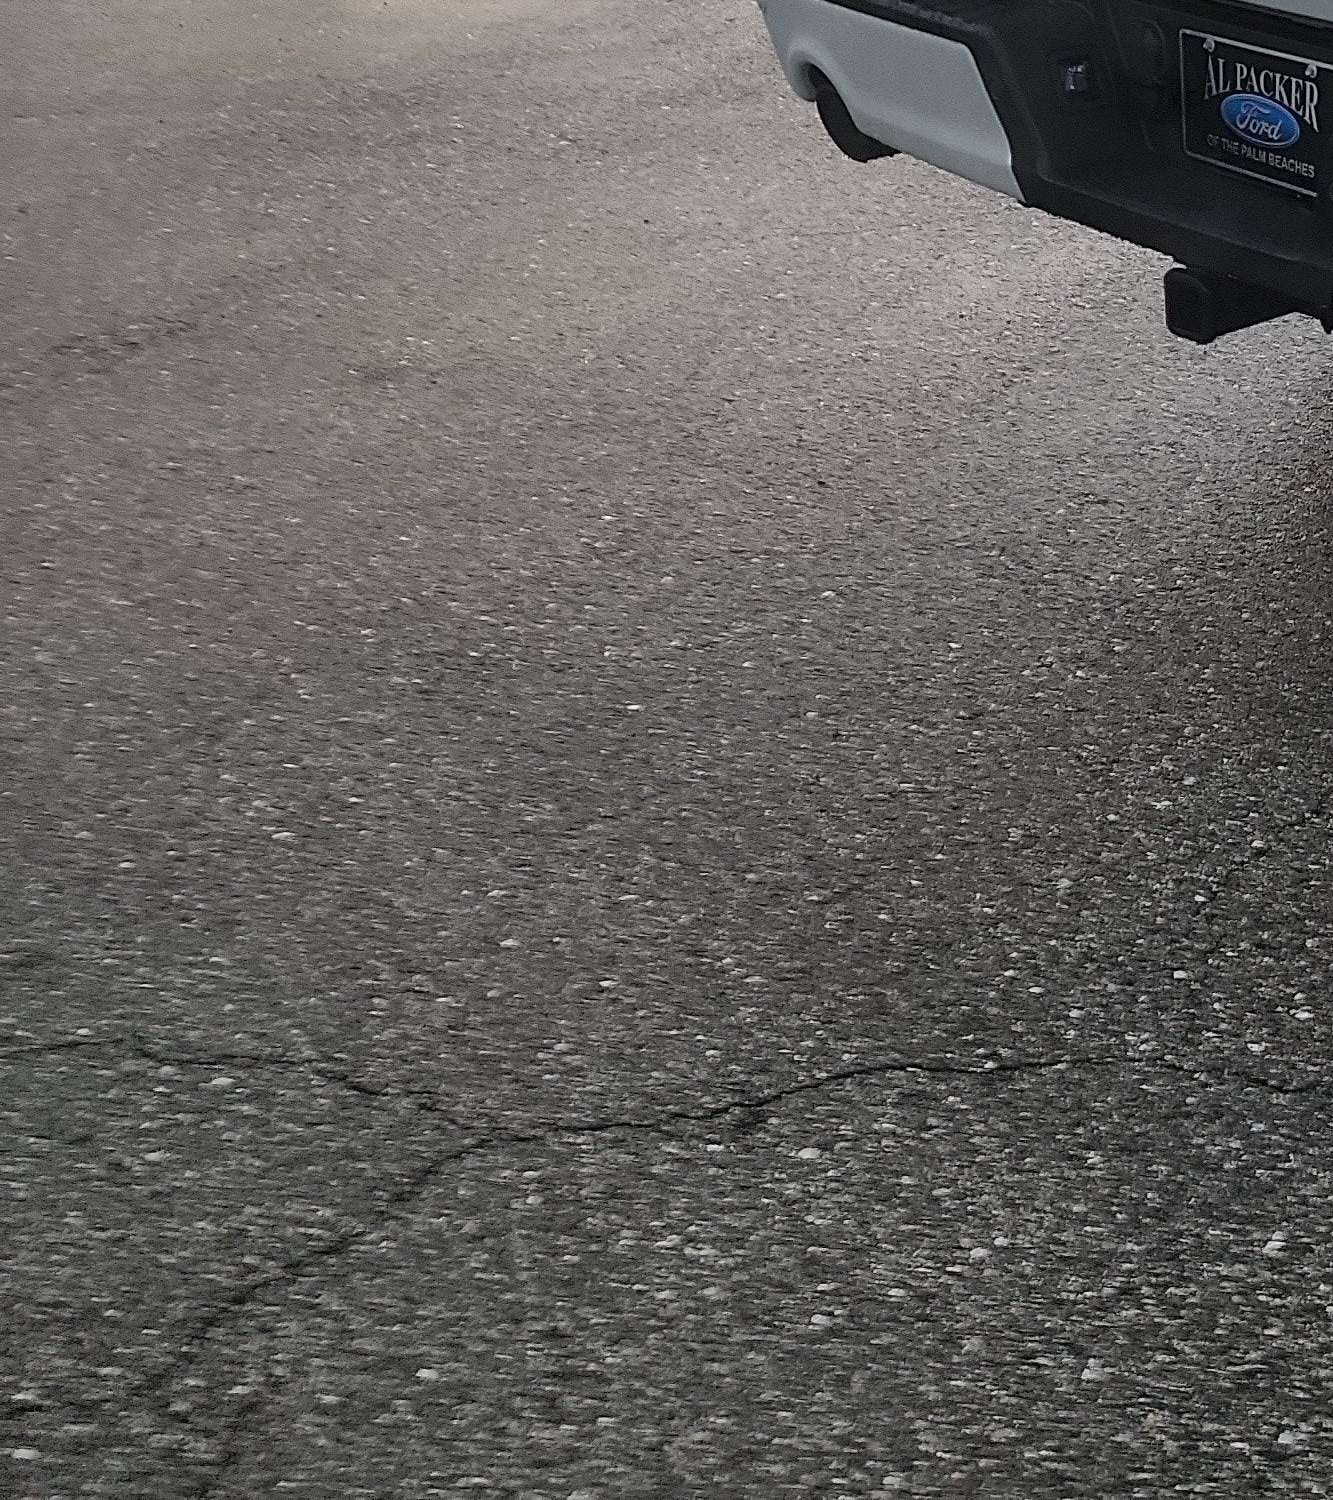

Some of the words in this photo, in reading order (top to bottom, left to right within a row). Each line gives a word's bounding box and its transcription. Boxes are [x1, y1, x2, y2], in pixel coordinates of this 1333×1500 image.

[1203, 54, 1231, 100] AL
[1235, 62, 1319, 133] PACKER
[1235, 100, 1283, 141] Ford
[1206, 134, 1220, 147] OF
[1221, 138, 1240, 155] THE
[1241, 144, 1267, 165] PALM
[1268, 152, 1316, 179] BEACHES
